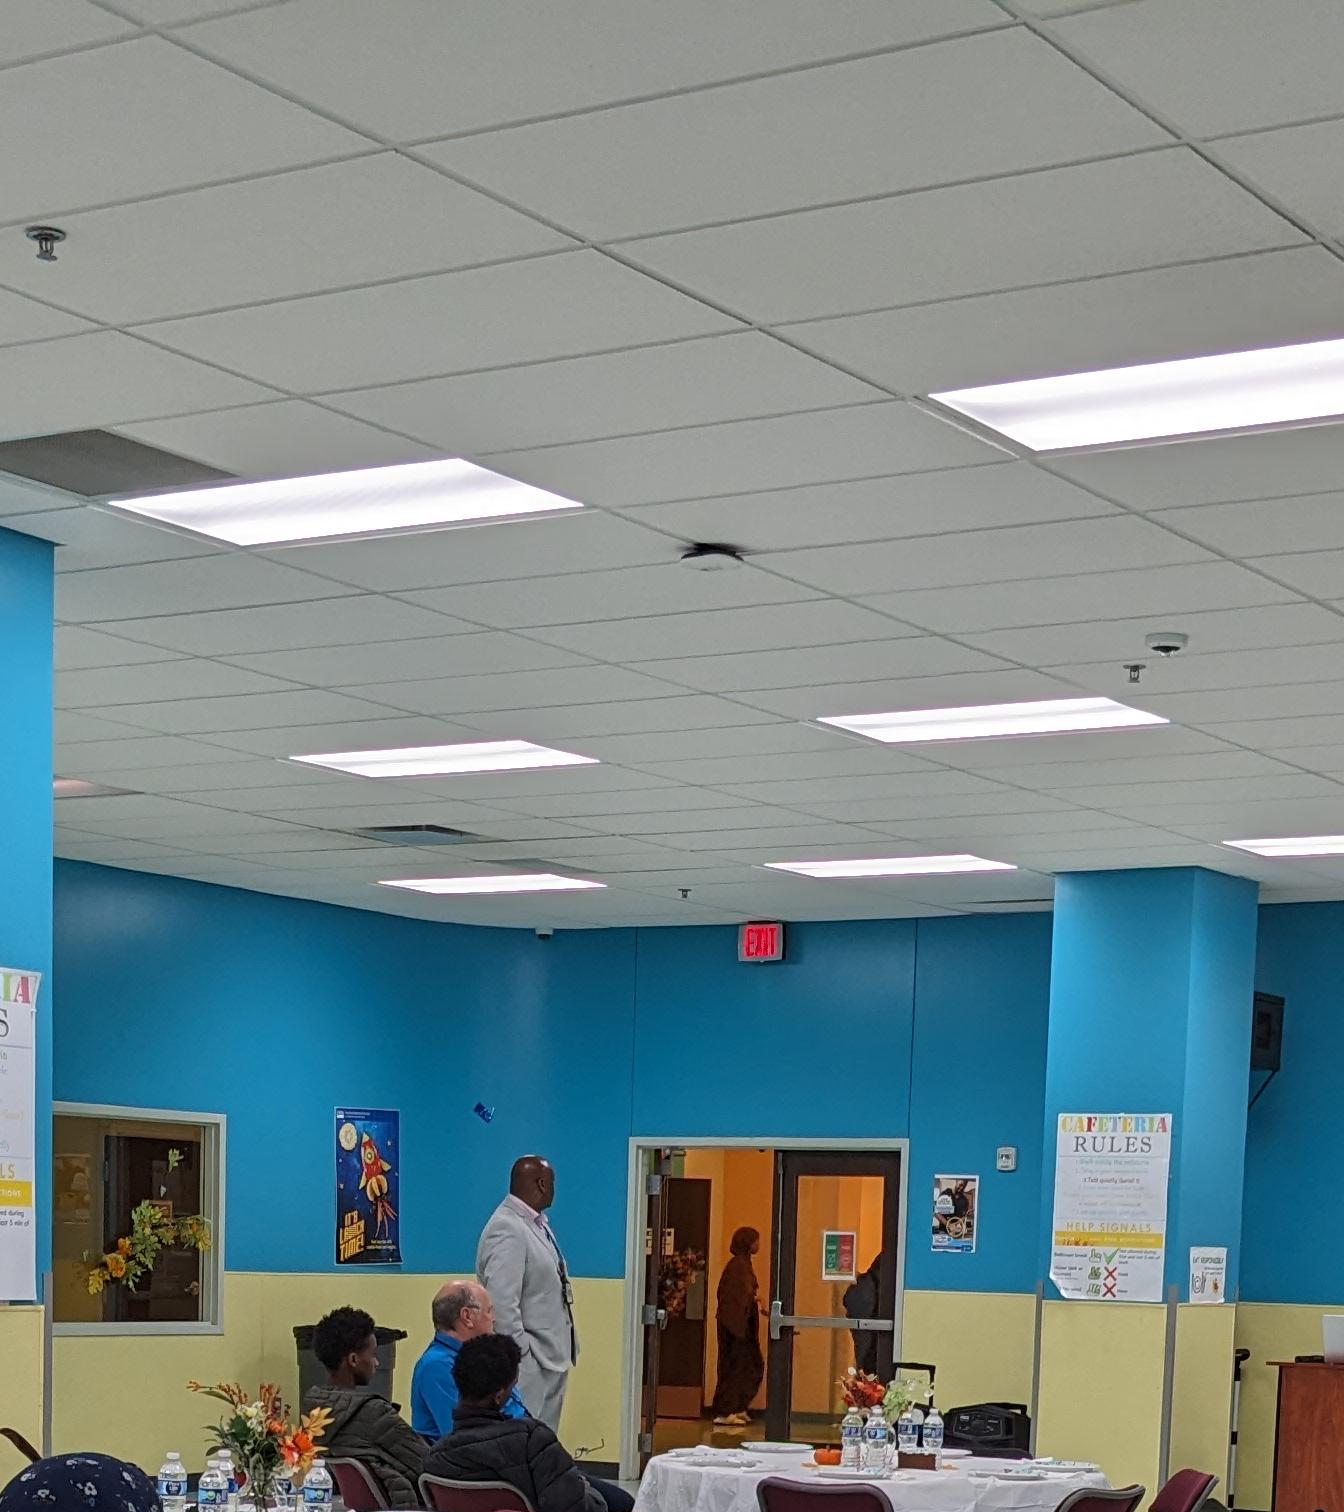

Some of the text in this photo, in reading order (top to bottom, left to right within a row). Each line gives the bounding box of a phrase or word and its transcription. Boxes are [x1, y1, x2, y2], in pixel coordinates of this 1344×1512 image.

[746, 928, 776, 957] EXIT
[1061, 1116, 1168, 1133] CAFETERIA
[1073, 1136, 1152, 1153] RULES
[1100, 1222, 1152, 1232] SIGNALS
